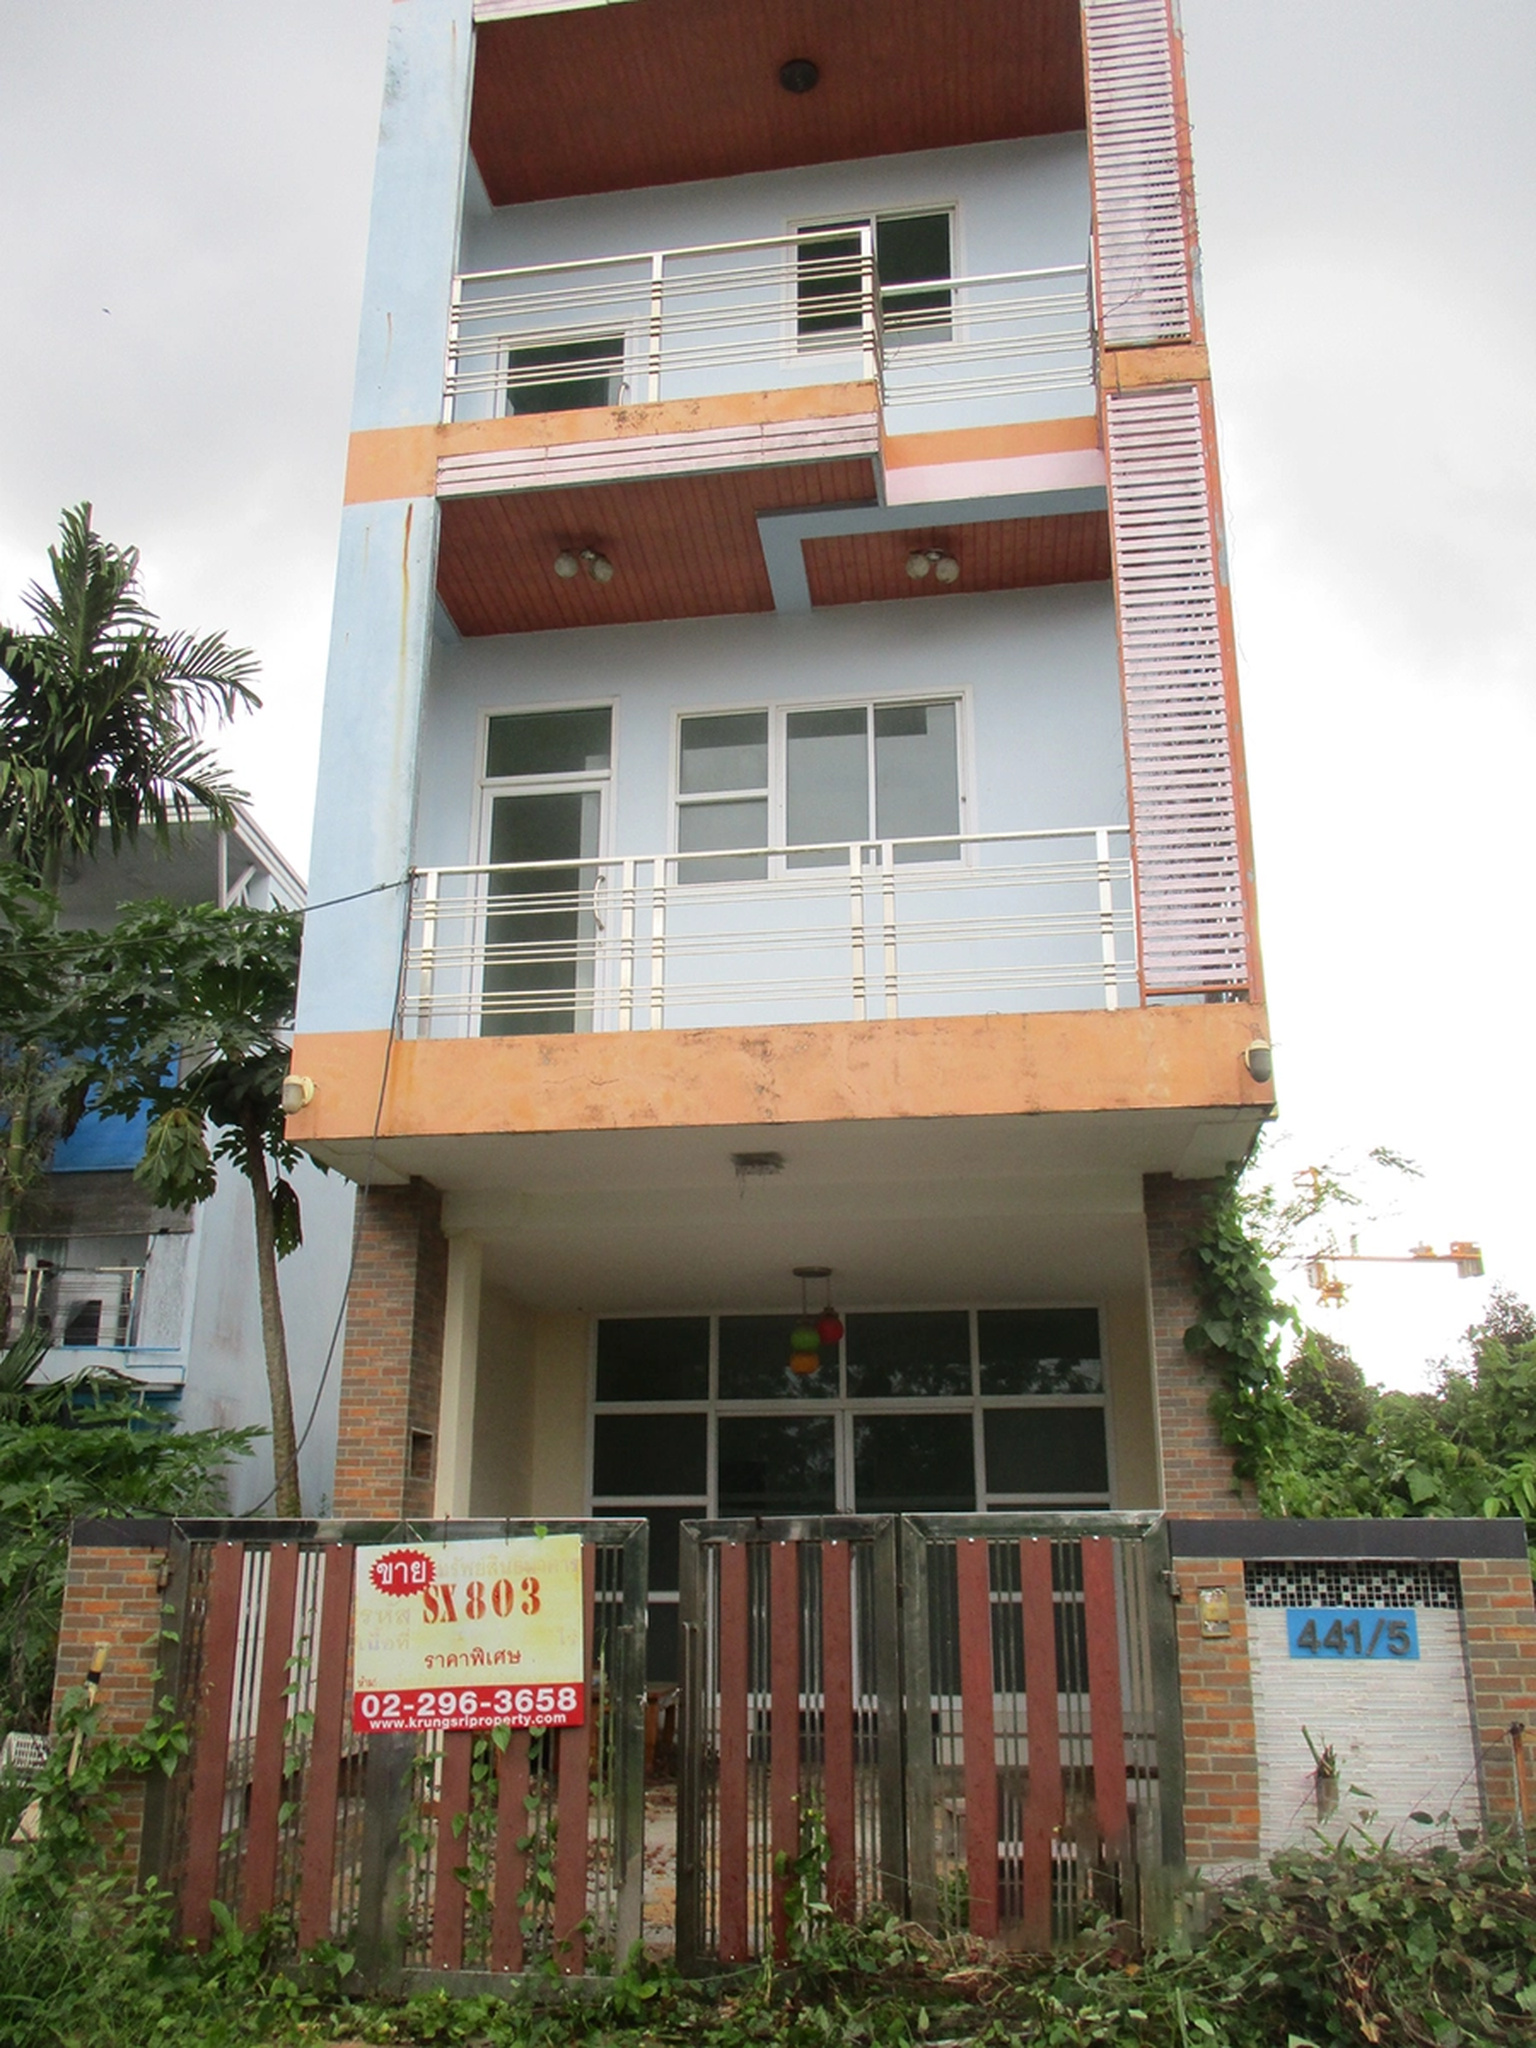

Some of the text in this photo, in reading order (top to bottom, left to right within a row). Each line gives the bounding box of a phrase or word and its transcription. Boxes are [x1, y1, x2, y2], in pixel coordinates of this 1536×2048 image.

[376, 1561, 426, 1584] ขาย
[1297, 1618, 1411, 1656] 441/5
[425, 1646, 521, 1669] ราคาพิเศษ
[361, 1687, 577, 1718] 02-296-3658
[370, 1712, 567, 1729] www.krungsriproperty.com
